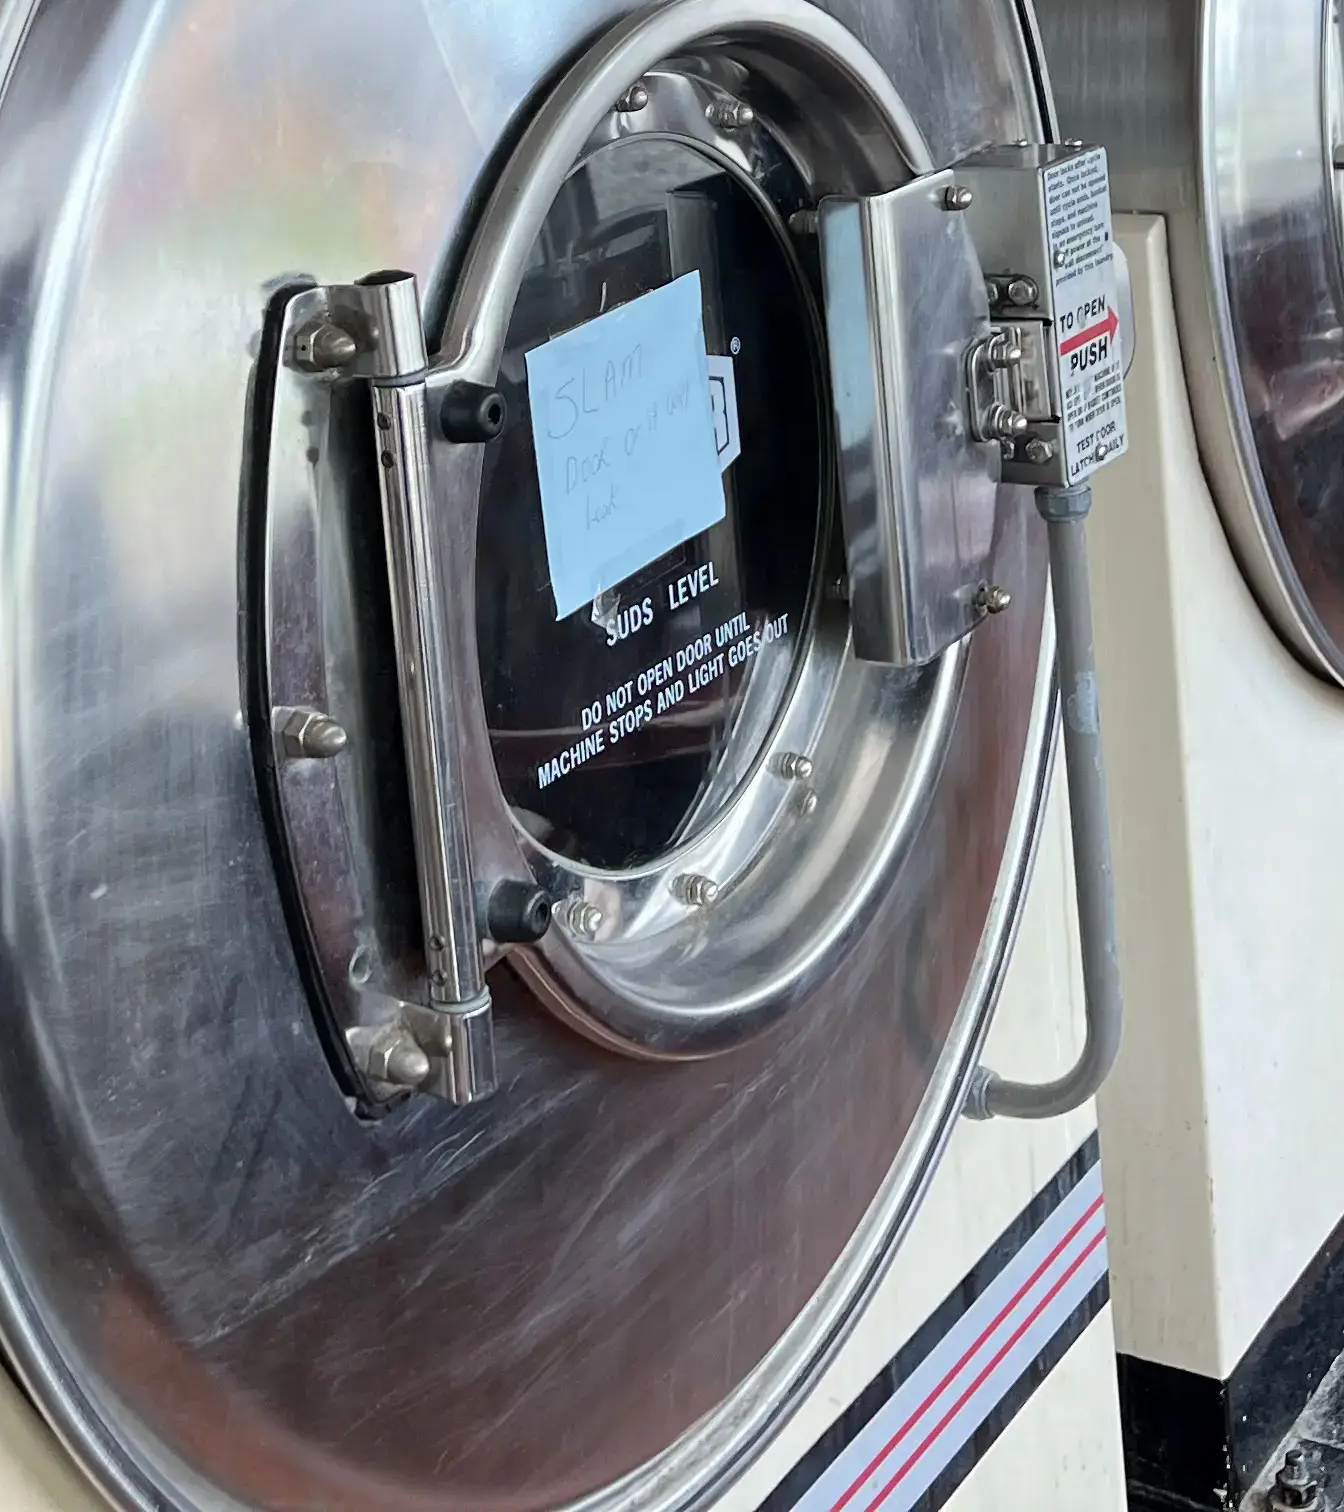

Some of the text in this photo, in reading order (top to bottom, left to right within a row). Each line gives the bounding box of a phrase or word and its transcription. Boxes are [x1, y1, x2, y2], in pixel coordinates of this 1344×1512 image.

[1060, 313, 1074, 333] TO
[1070, 336, 1108, 376] PUSH
[1076, 432, 1094, 454] TEST
[606, 561, 719, 647] SUDS LEVEL
[537, 613, 789, 789] MACHINE STOPS AND LIGHT GOES OUT
[582, 611, 751, 730] DO NOT OPEN DOOR UNTIL
